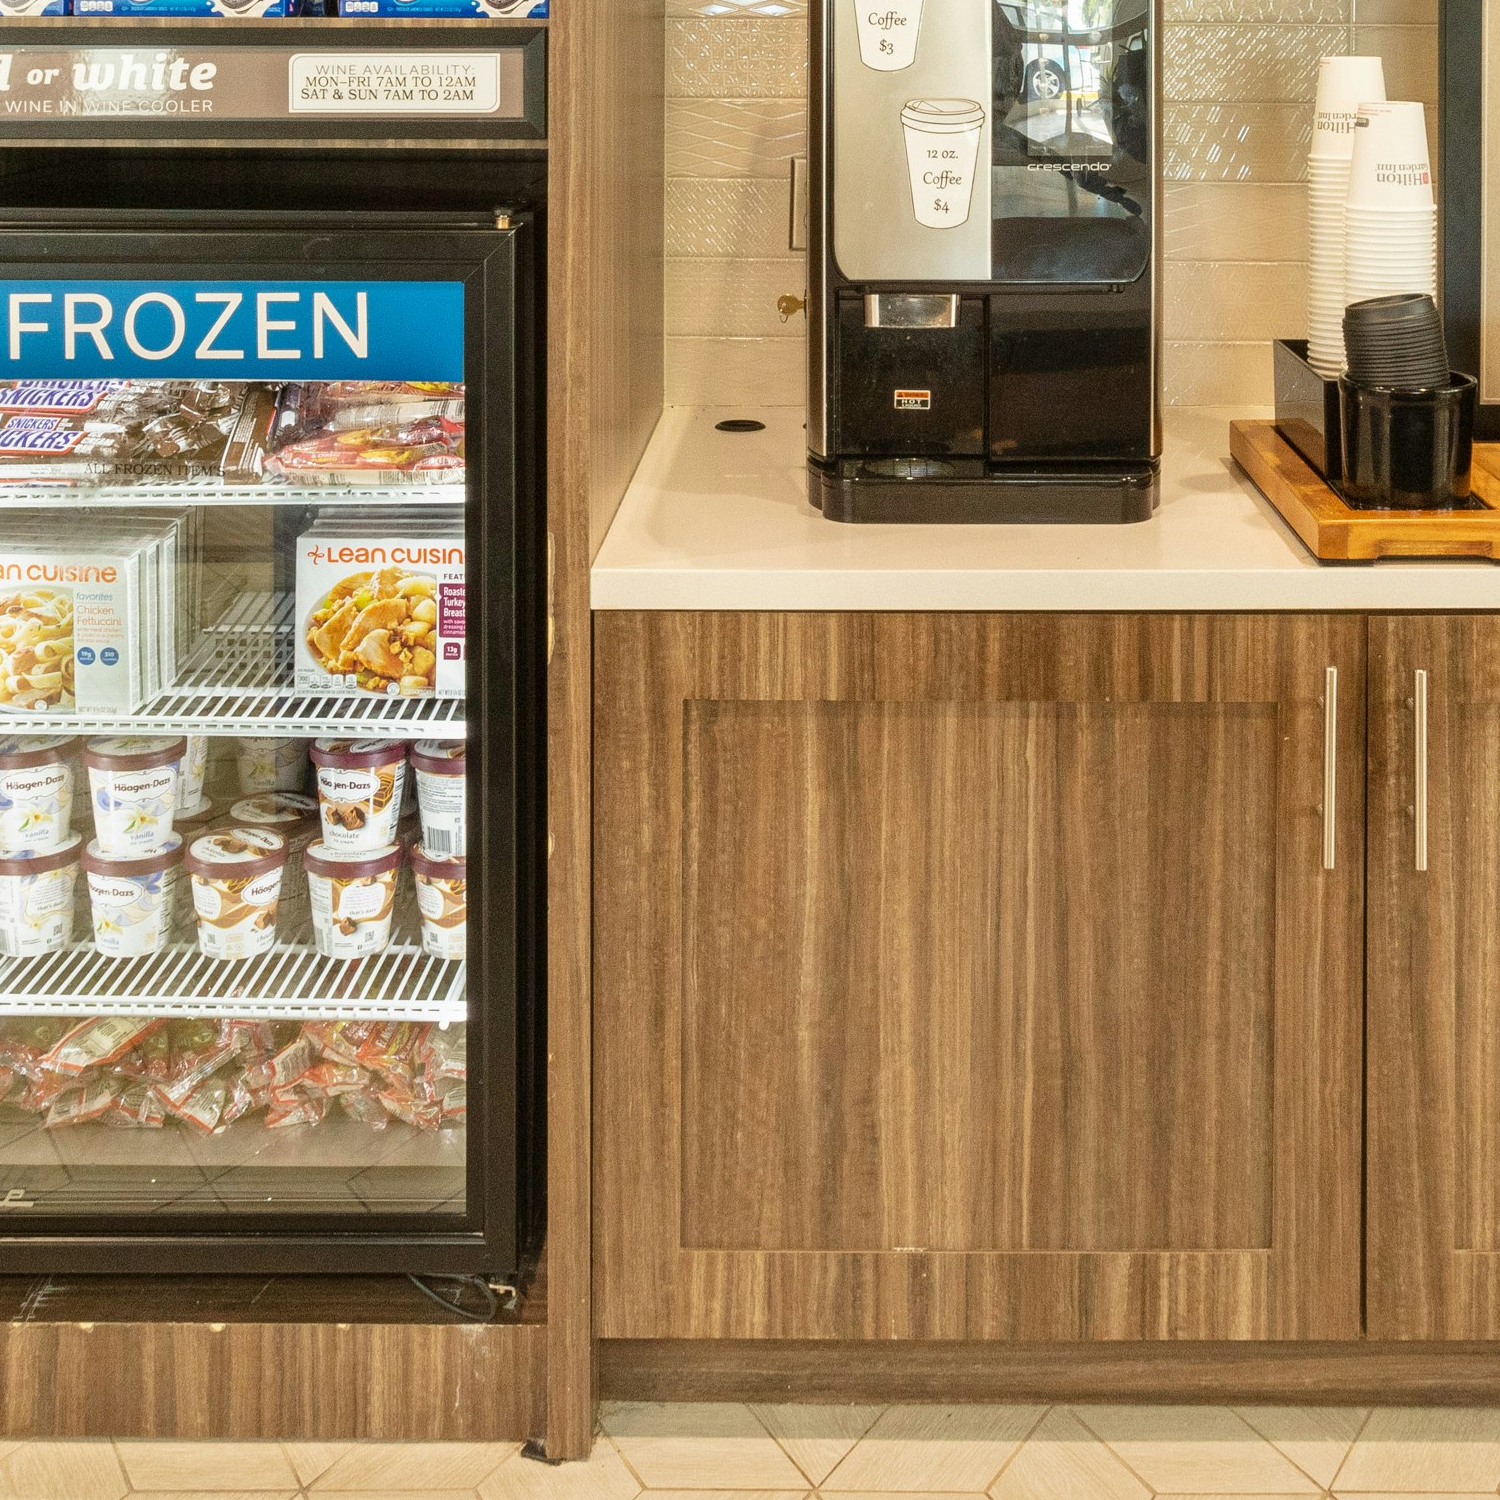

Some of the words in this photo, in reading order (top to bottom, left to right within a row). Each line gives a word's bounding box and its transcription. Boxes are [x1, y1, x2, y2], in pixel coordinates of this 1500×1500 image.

[868, 12, 906, 30] Coffee
[879, 39, 894, 54] $3
[27, 67, 59, 85] or
[73, 53, 217, 90] white
[316, 65, 356, 75] WINE
[363, 65, 475, 75] AVAILABILITY:
[377, 76, 406, 87] 7AM
[412, 76, 432, 87] TO
[439, 76, 476, 87] 12AM
[301, 89, 328, 100] SAT
[333, 89, 343, 100] &
[349, 89, 378, 100] SUN
[384, 89, 413, 100] 7AM
[419, 90, 438, 100] TO
[444, 90, 474, 100] 2AM
[5, 100, 52, 113] WINE
[60, 100, 77, 113] IN
[84, 100, 131, 113] WINE
[139, 100, 212, 113] COOLER
[927, 150, 938, 159] 12
[942, 150, 958, 159] oz.
[1027, 162, 1109, 171] crescendo
[923, 171, 962, 190] Coffee
[1377, 172, 1422, 186] Hilton
[934, 199, 950, 214] $4
[9, 292, 368, 361] FROZEN
[7, 418, 56, 430] SNICKERS
[84, 464, 110, 475] ALL
[115, 464, 172, 476] FROZEN
[178, 465, 226, 477] ITEM'S
[77, 606, 114, 614] Chicken
[77, 617, 122, 625] Fettuccini
[7, 774, 65, 791] Häagen-Dazs
[114, 776, 171, 792] Häagen-Dazs
[25, 829, 49, 839] vanilla
[130, 831, 155, 840] vanilla
[329, 831, 360, 840] chocolate
